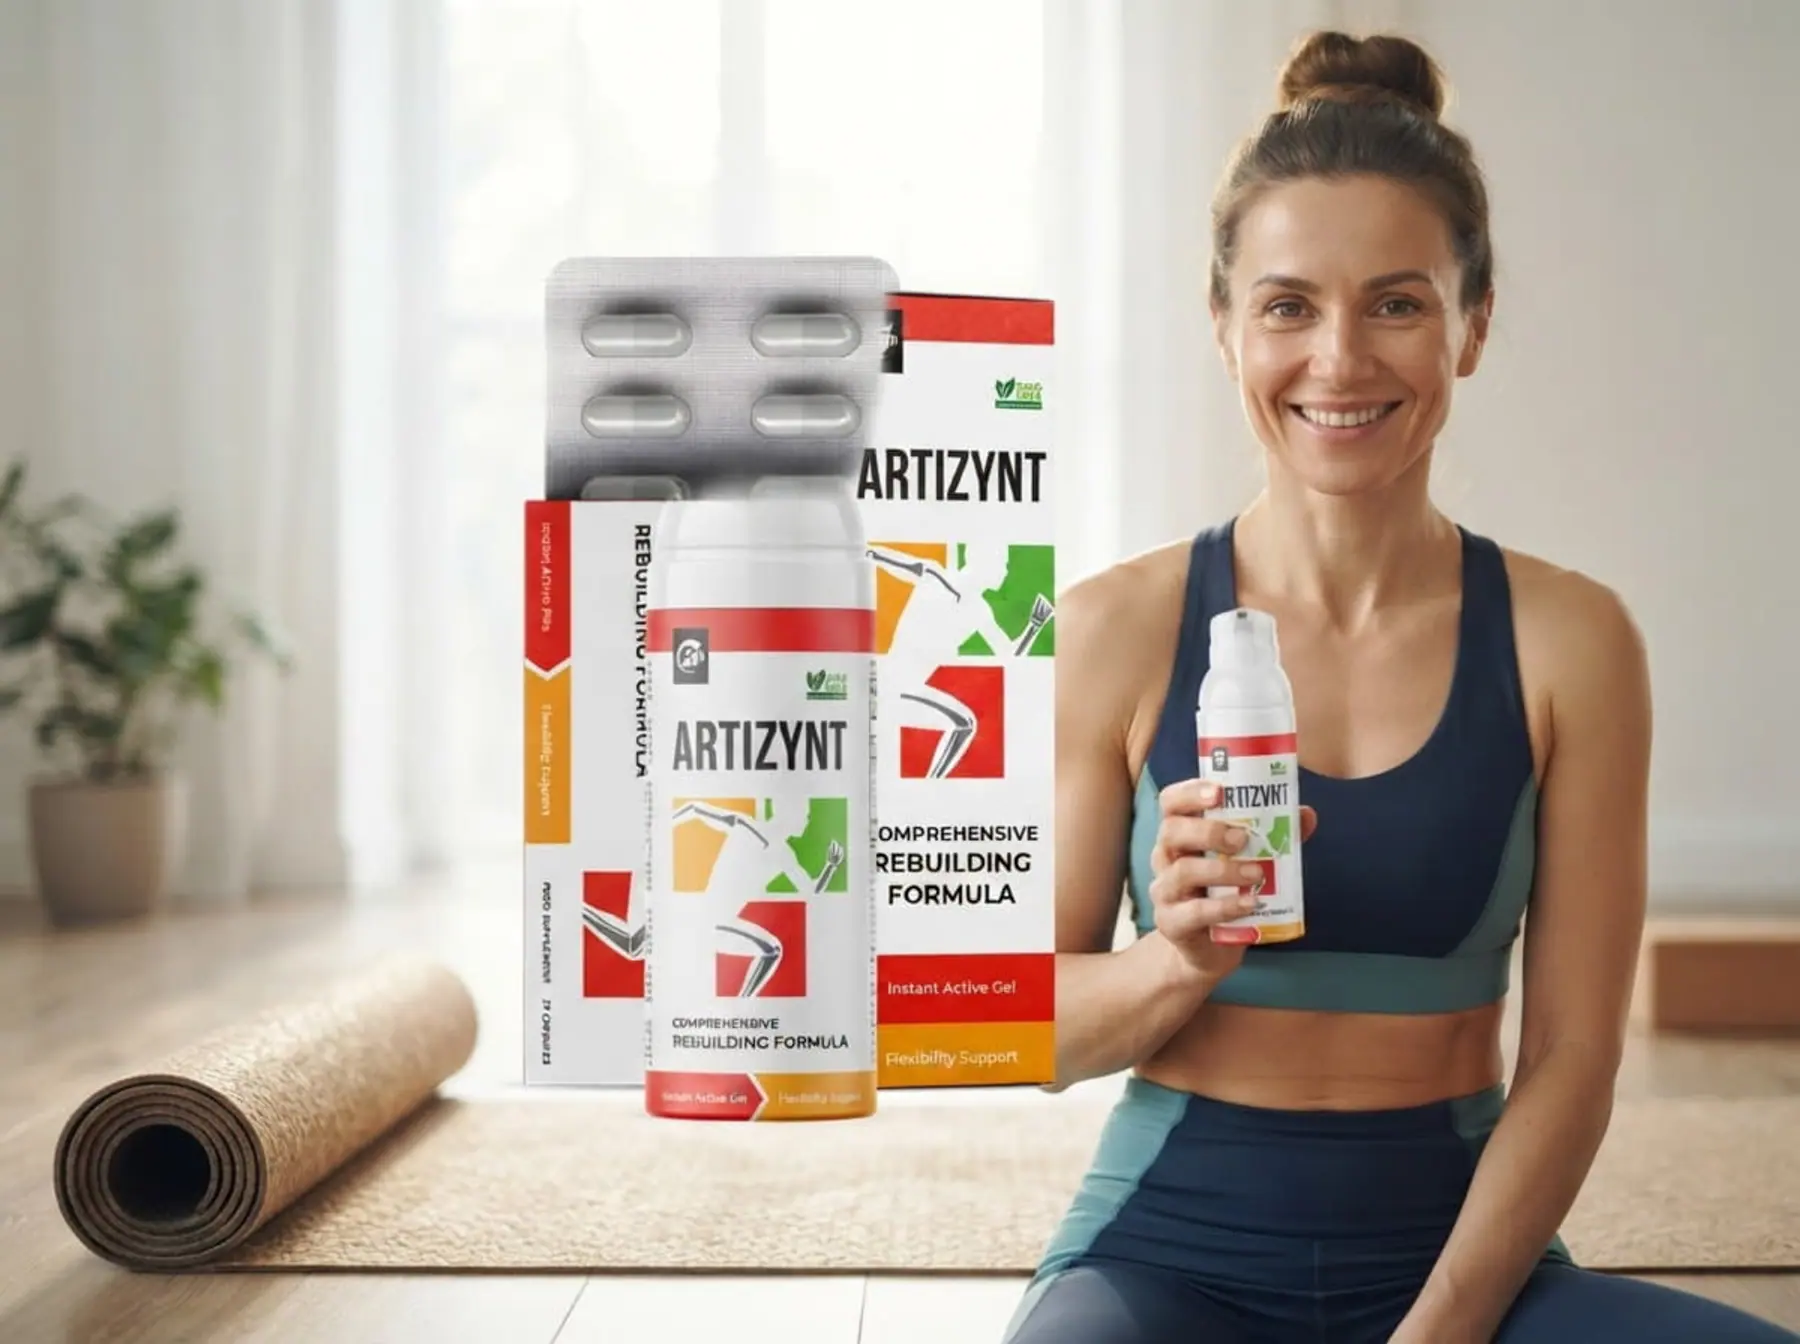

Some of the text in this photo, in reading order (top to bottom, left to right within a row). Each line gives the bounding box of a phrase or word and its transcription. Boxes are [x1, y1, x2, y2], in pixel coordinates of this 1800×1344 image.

[857, 448, 1047, 503] ARTIZYNT
[672, 720, 848, 771] ARTIZYNT
[878, 825, 1039, 842] OMPREHENSIVE
[876, 851, 1032, 874] REBUILDING
[888, 883, 1016, 906] FORMULA
[887, 979, 1017, 995] Instant Active Gel
[773, 1034, 850, 1050] FORMULA
[959, 1049, 1019, 1068] Support
